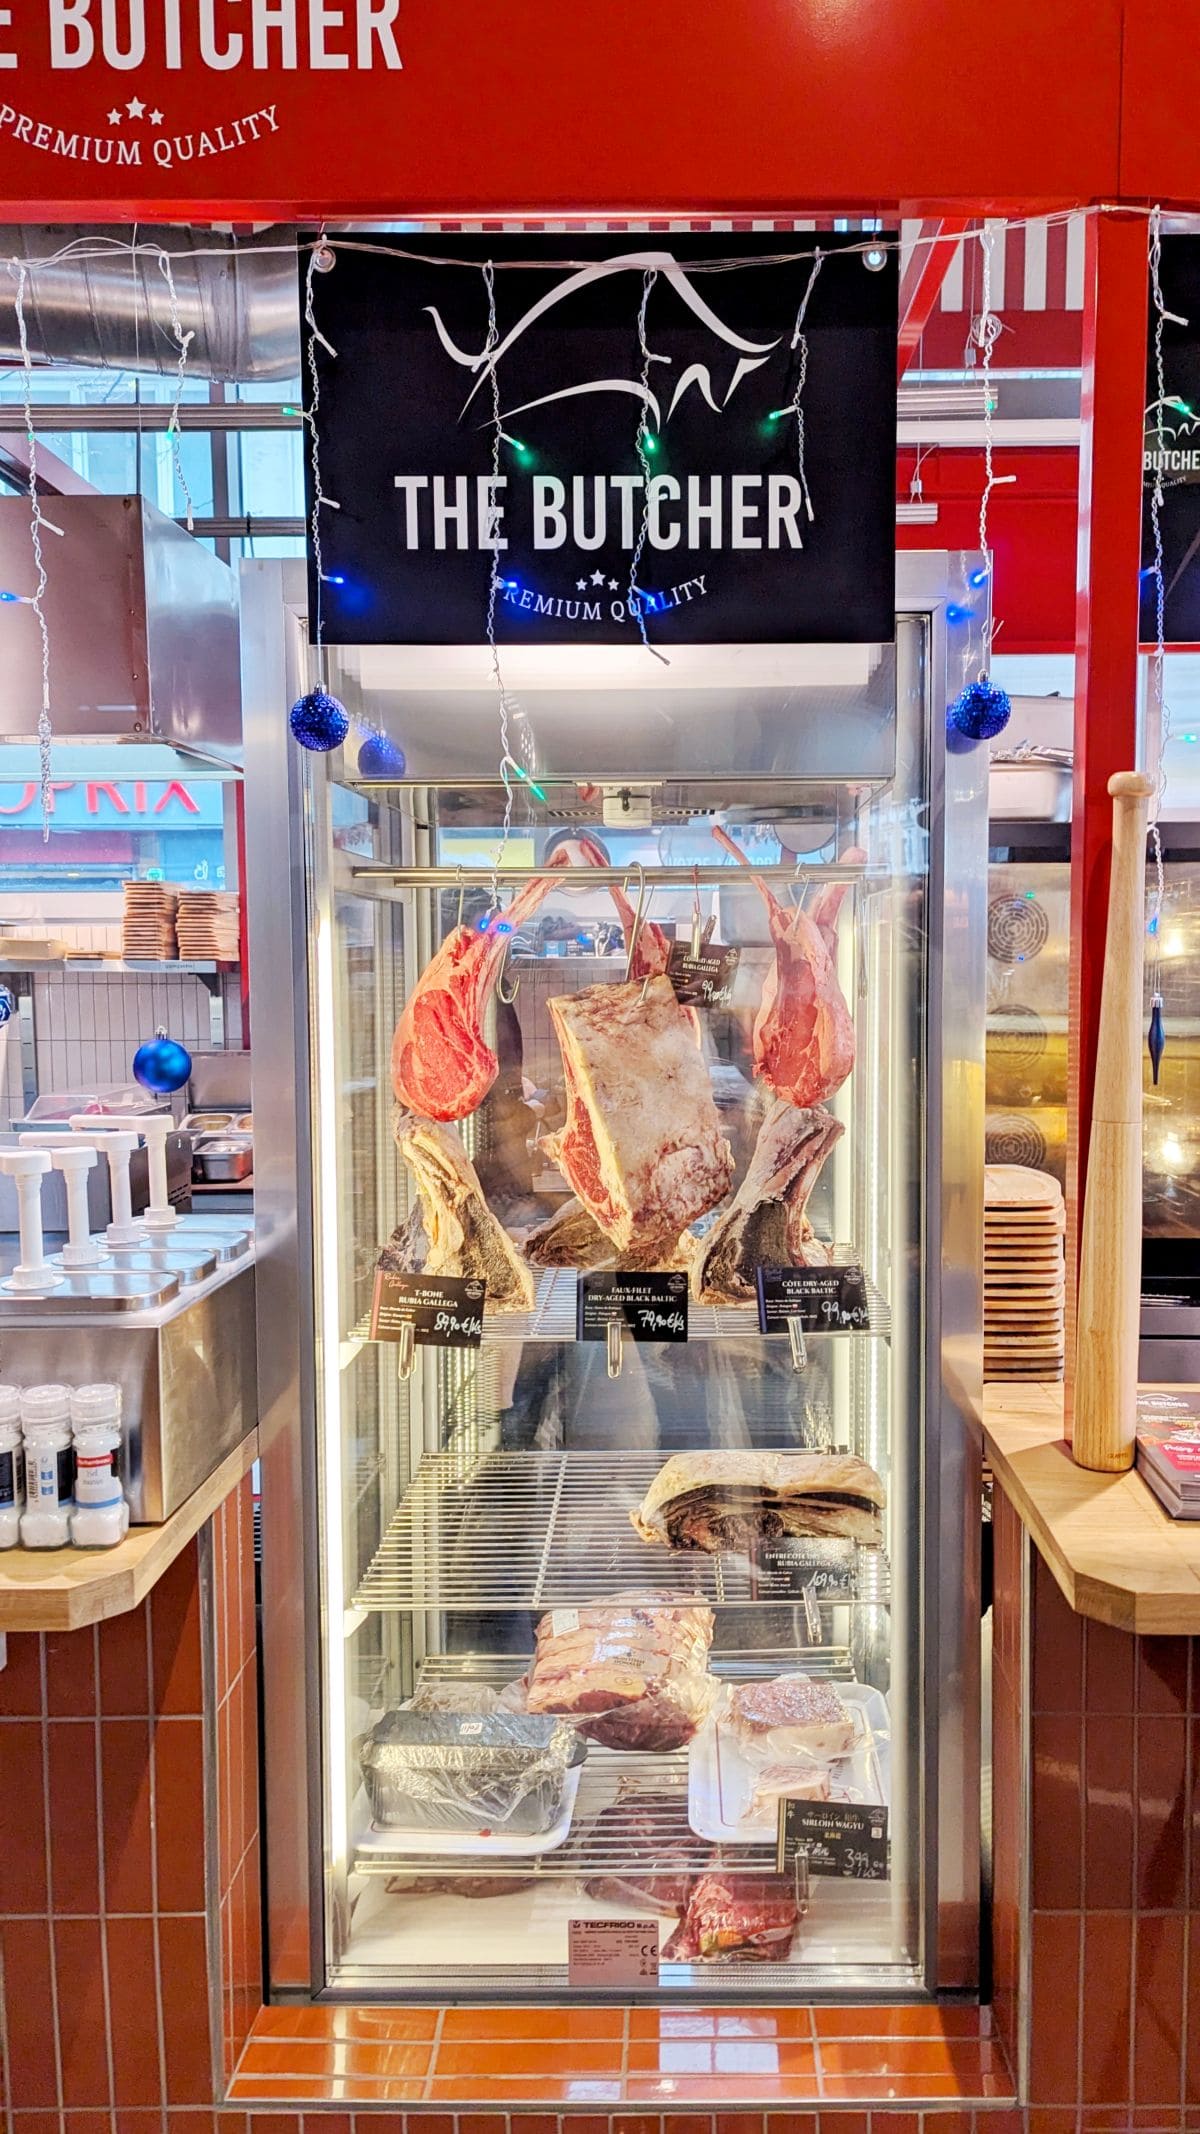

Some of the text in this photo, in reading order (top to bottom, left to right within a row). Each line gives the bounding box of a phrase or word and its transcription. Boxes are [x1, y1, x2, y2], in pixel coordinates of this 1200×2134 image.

[0, 104, 281, 168] PREMIUM QUALITY
[394, 475, 804, 550] THE BUTCHER
[611, 574, 708, 623] QUALITY
[423, 1298, 458, 1308] GALLEGA
[835, 1821, 865, 1830] WAGYU
